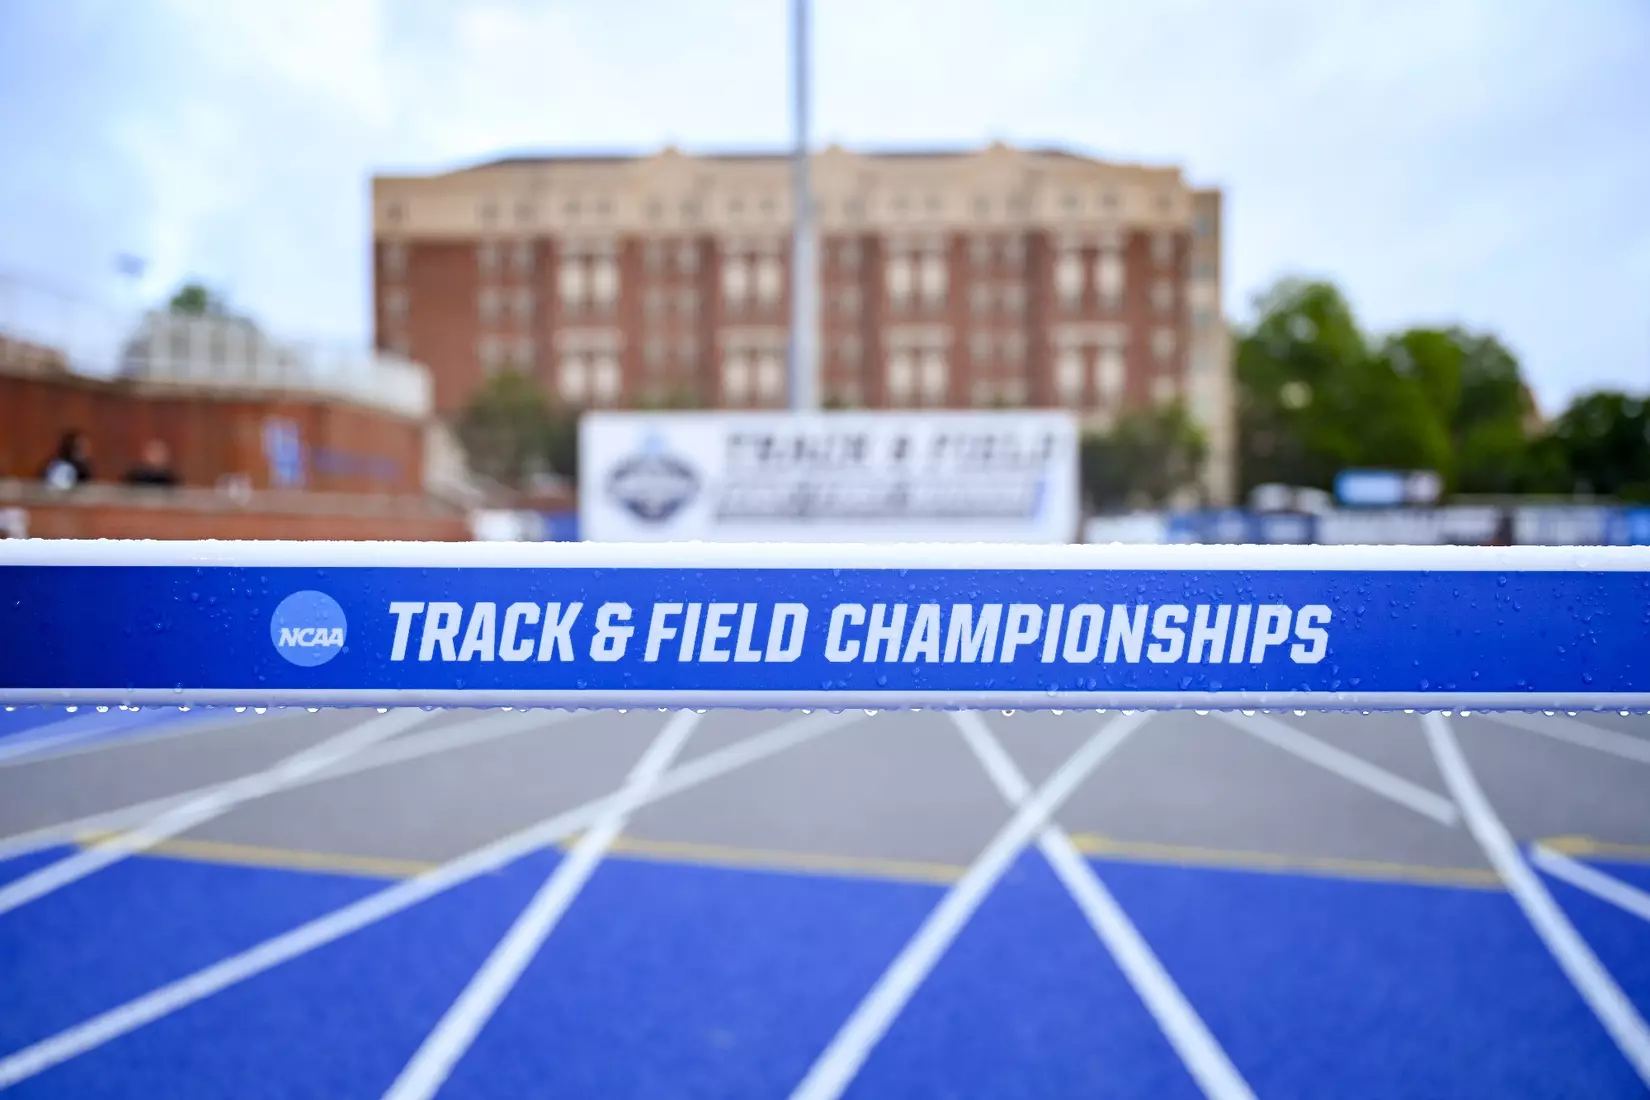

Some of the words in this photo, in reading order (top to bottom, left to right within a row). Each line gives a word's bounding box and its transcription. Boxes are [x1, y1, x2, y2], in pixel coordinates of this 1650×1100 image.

[278, 627, 345, 647] NCAA
[389, 601, 583, 662] TRACK
[589, 602, 635, 662] &
[644, 602, 809, 663] FIELD
[824, 603, 1332, 664] CHAMPIONSHIPS
